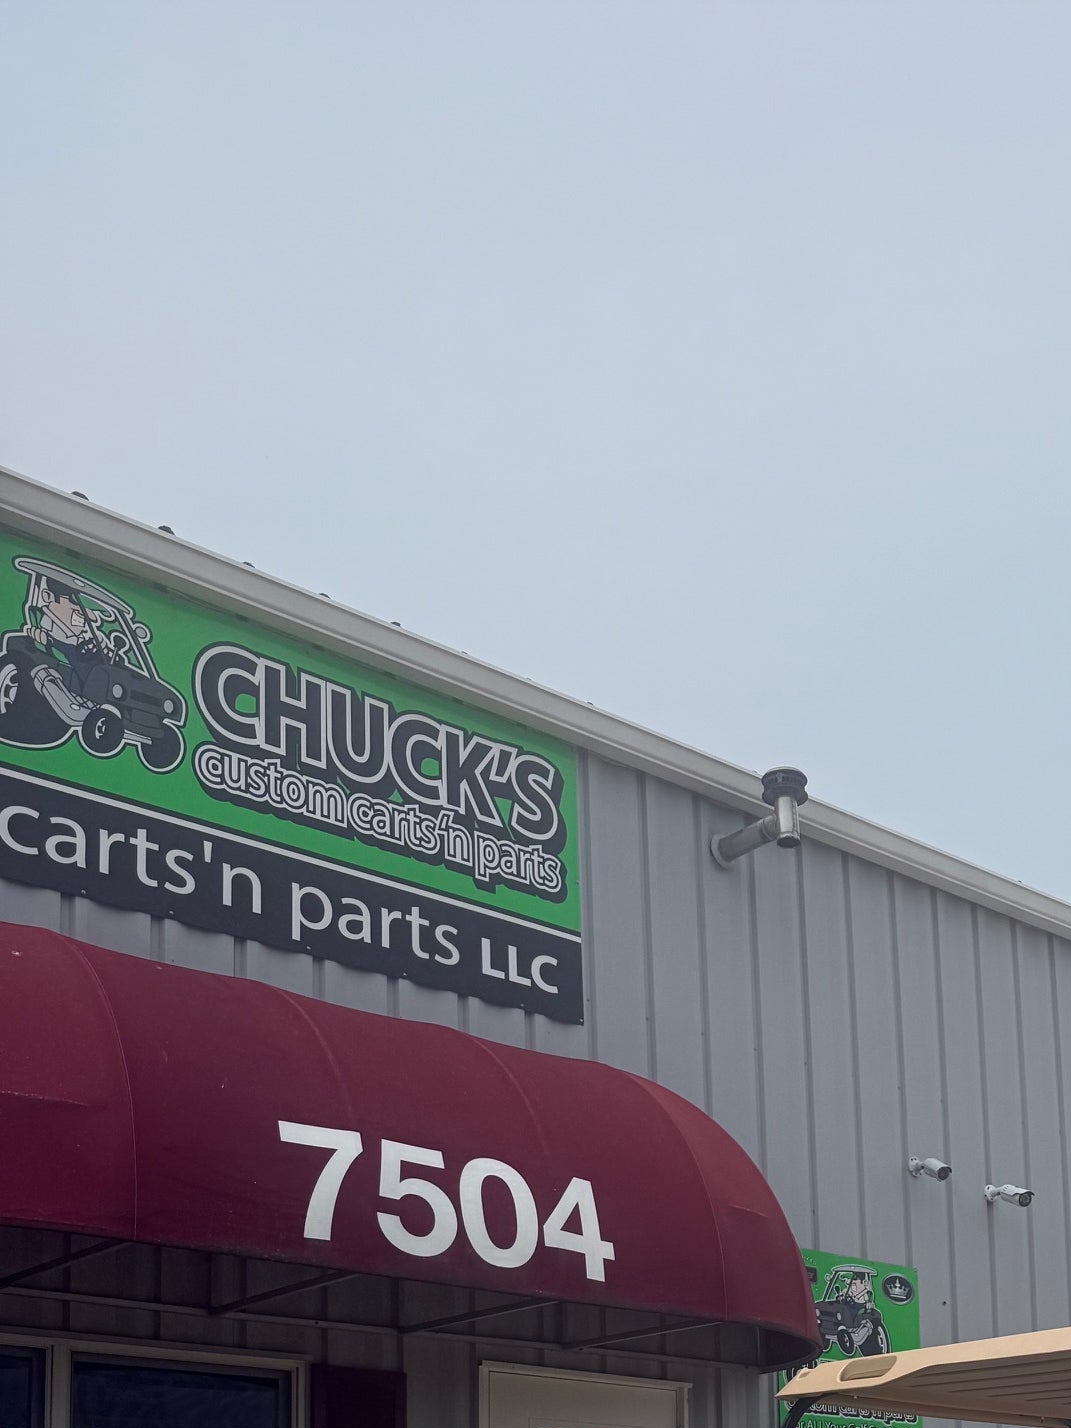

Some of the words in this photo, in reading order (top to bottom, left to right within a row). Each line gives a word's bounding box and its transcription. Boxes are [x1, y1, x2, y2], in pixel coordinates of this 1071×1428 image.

[195, 644, 560, 840] CHUCK'S
[196, 745, 347, 827] custom
[475, 831, 562, 893] parts
[292, 881, 460, 967] parts
[480, 937, 559, 995] LLC
[278, 1119, 615, 1283] 7504
